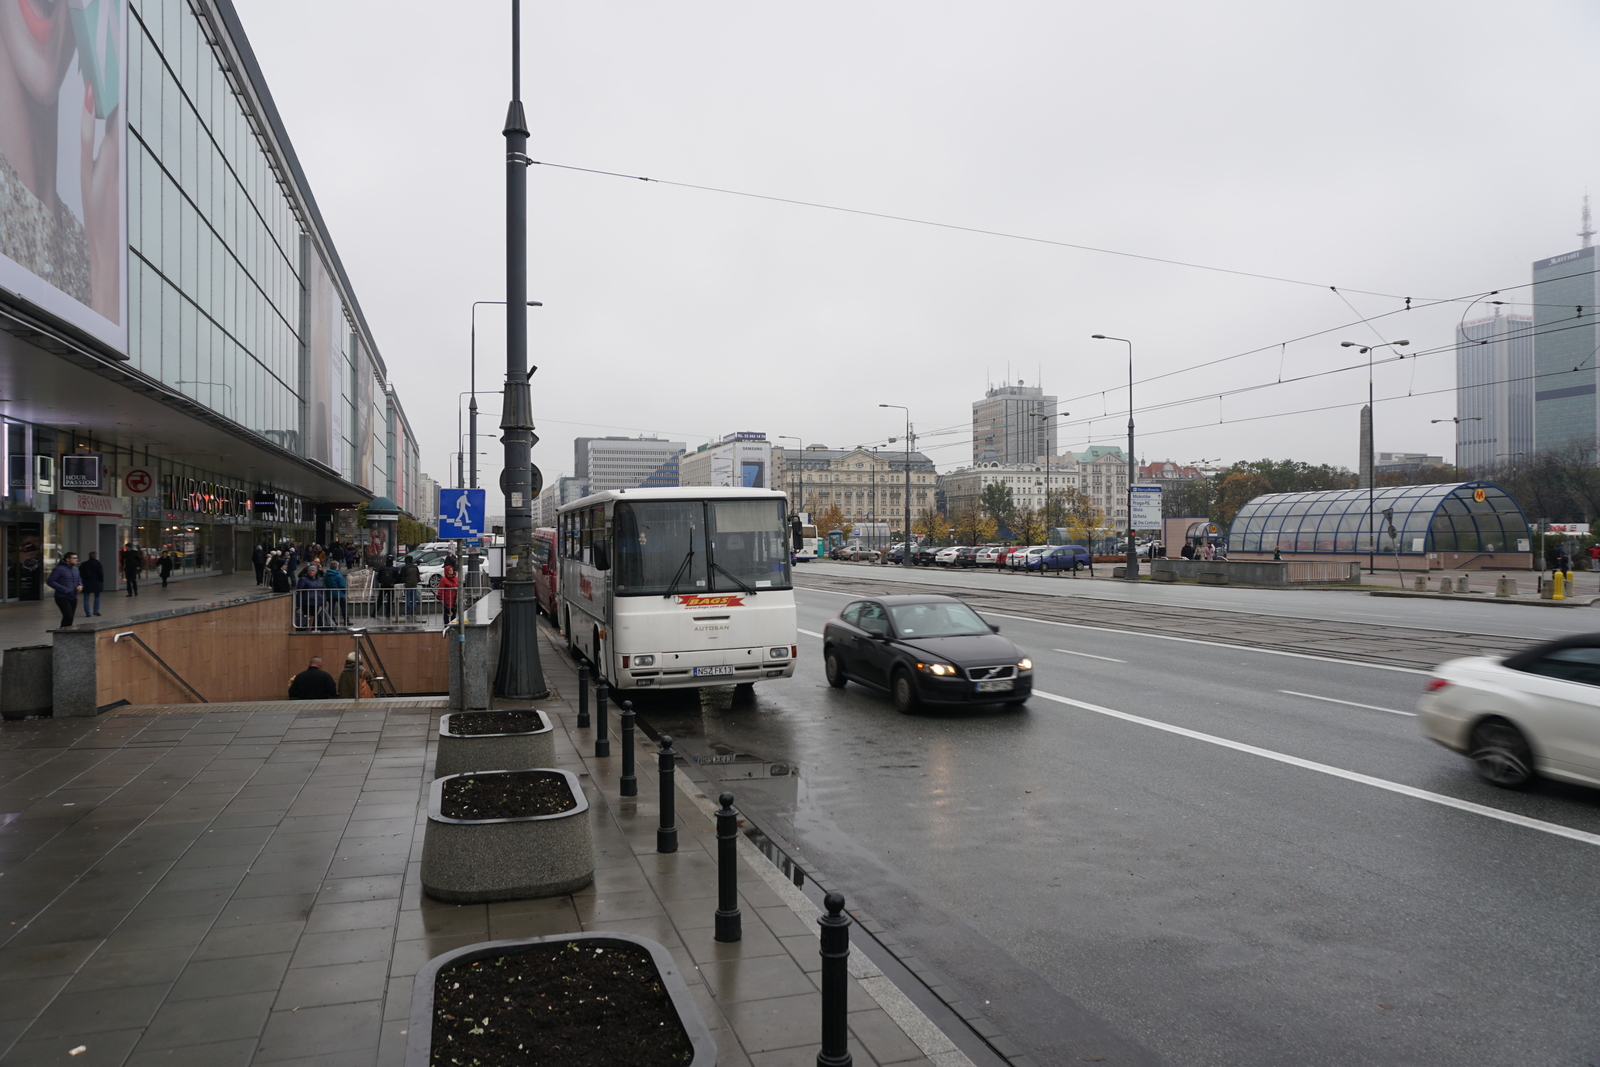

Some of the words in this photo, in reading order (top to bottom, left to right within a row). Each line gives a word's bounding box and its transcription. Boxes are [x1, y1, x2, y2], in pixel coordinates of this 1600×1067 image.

[1548, 251, 1580, 267] Marriott
[1475, 490, 1484, 500] M
[77, 494, 112, 511] ROSSMANN
[688, 597, 729, 605] BAGS
[697, 667, 712, 676] NSZ
[714, 665, 732, 675] FK13
